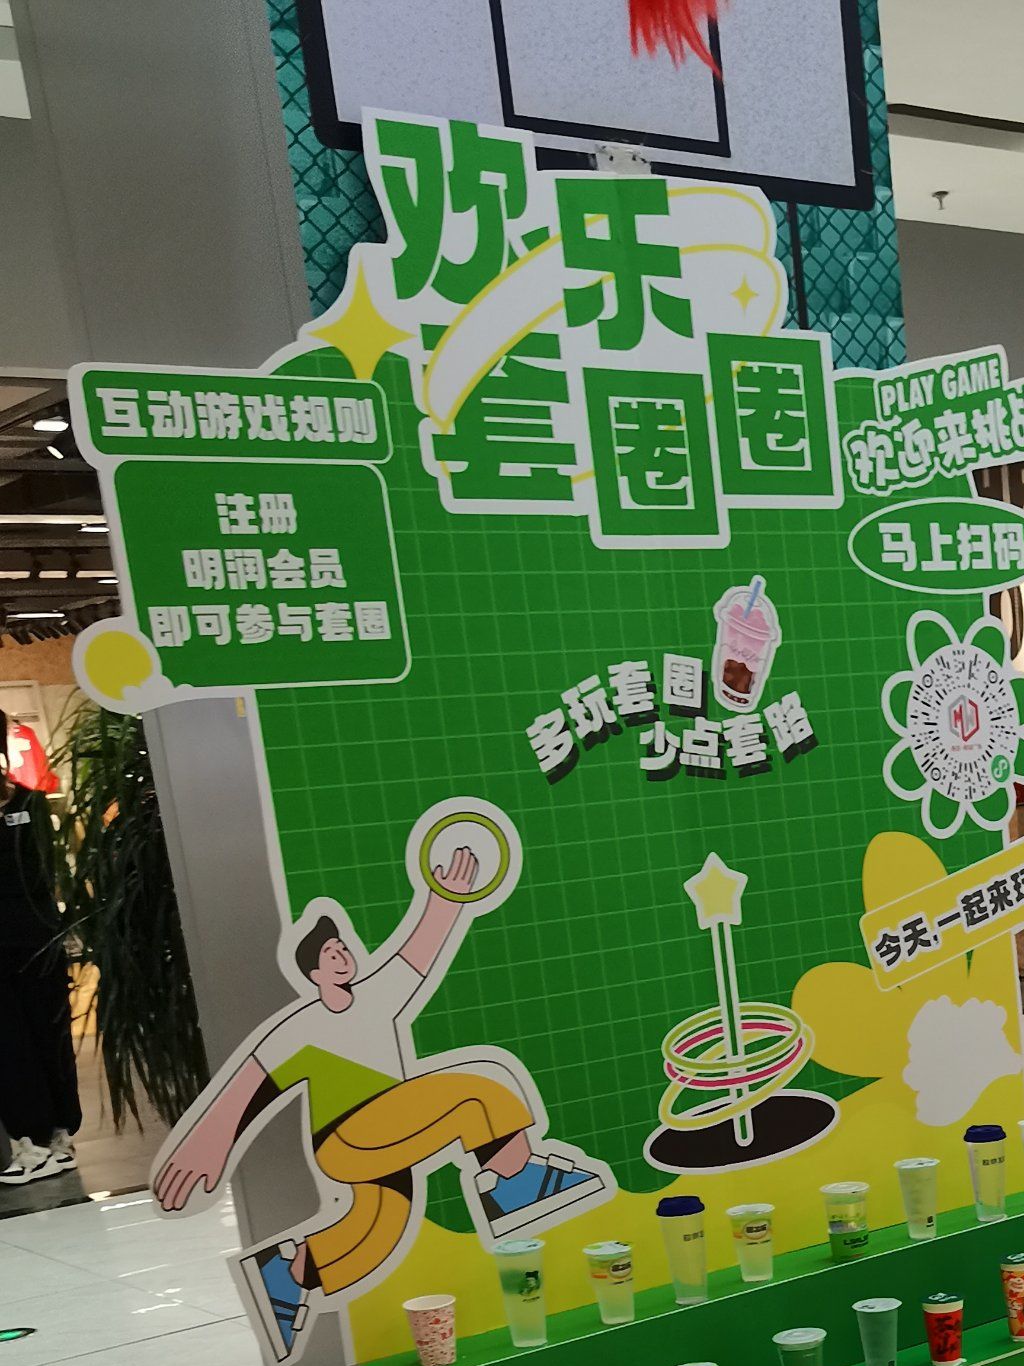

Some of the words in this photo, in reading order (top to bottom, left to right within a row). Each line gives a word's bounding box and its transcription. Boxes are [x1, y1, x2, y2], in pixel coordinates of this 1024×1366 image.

[374, 118, 695, 352] 欢乐
[96, 388, 378, 443] 互动游戏规则
[881, 374, 935, 416] PLAY
[942, 358, 1001, 400] GAME
[420, 324, 836, 536] 套圈圈
[215, 493, 298, 536] 注册
[181, 548, 347, 591] 明润会员
[147, 601, 392, 648] 即可参与套圈
[526, 653, 704, 774] 多玩套圈
[640, 691, 814, 771] 少点套路
